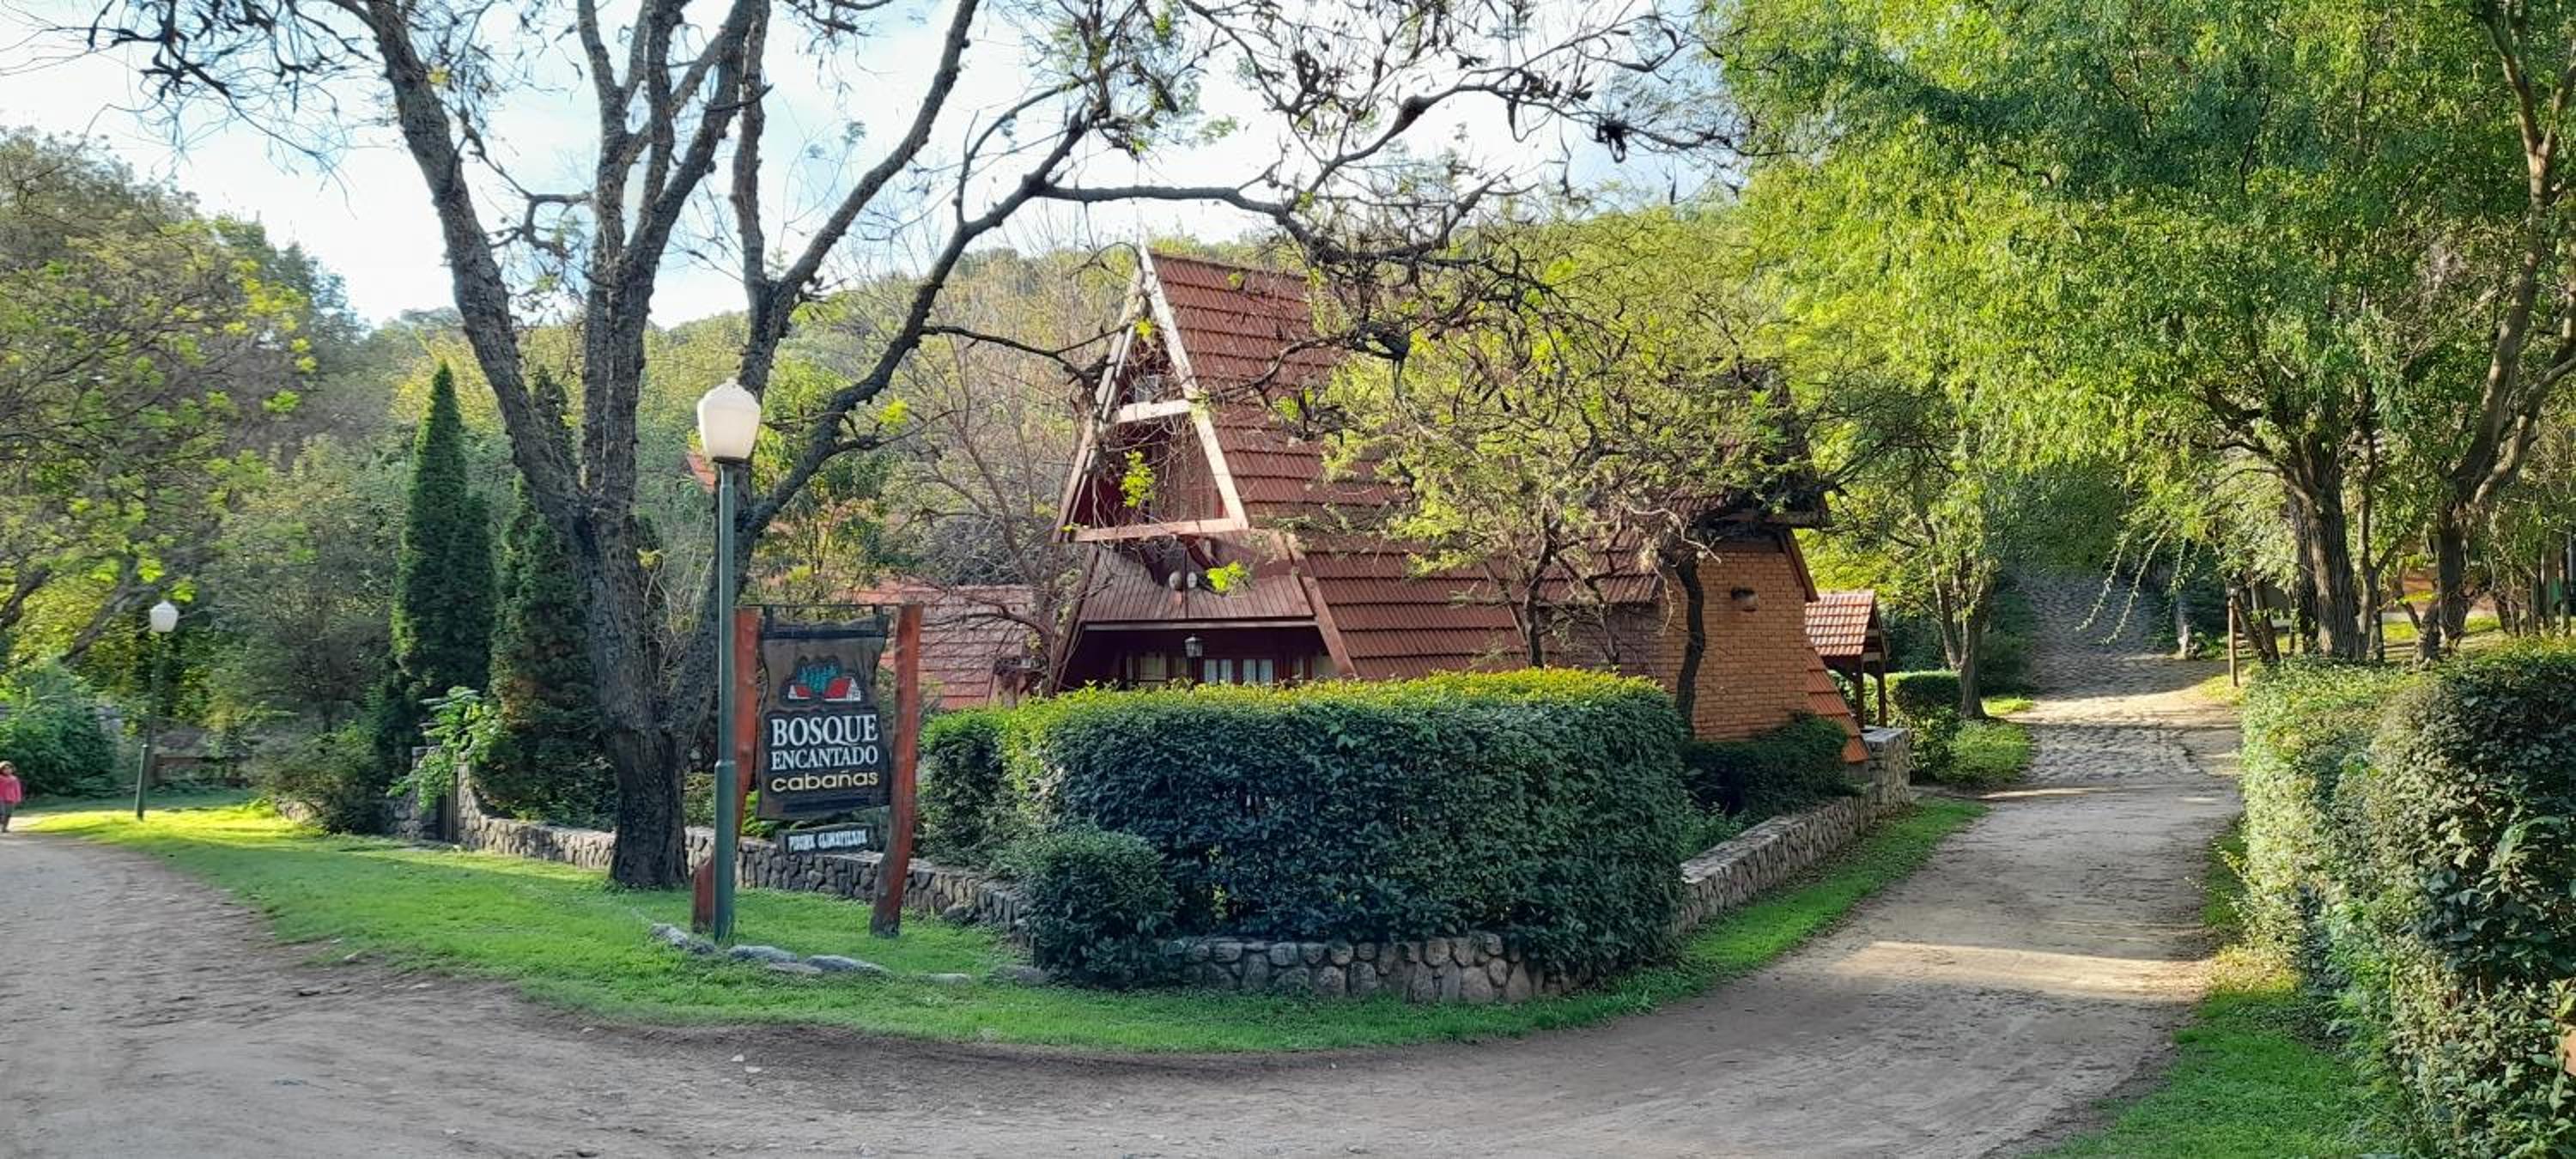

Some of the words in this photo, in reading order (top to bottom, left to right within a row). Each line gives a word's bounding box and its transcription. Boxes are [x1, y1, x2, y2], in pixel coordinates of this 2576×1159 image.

[771, 714, 878, 746] BOSQUE
[771, 745, 878, 770] ENCANTADO
[771, 770, 878, 792] cabañas
